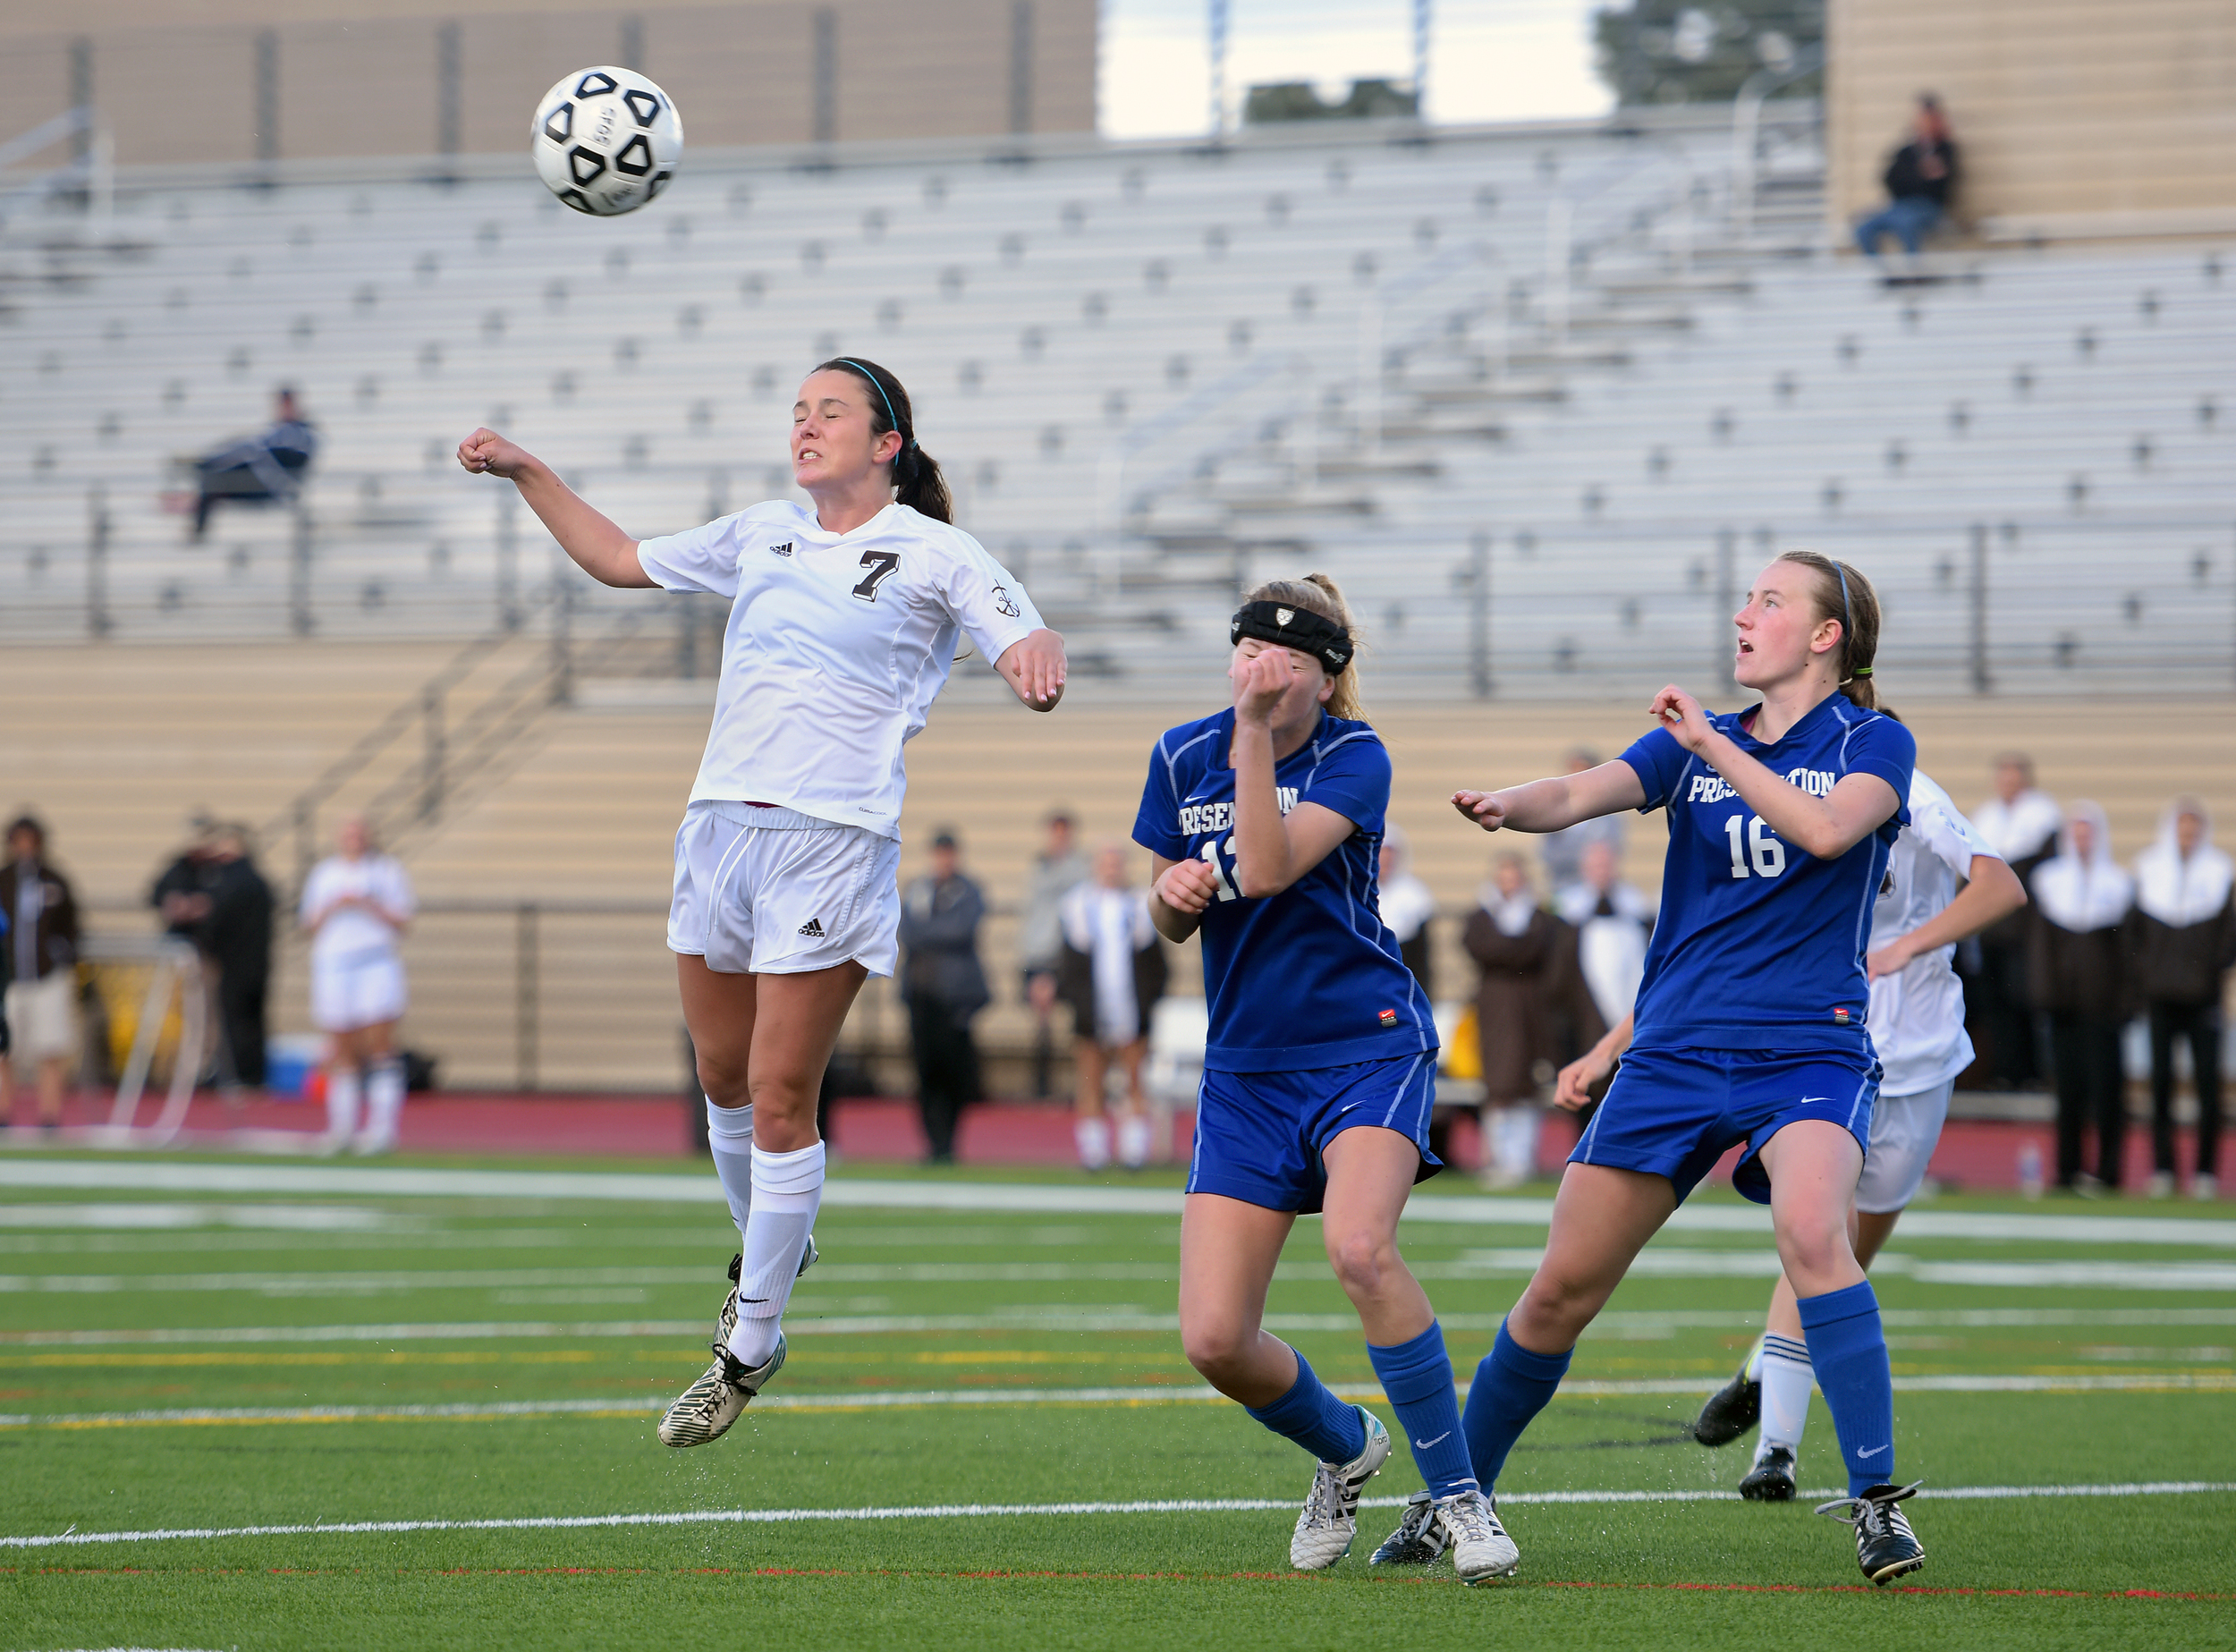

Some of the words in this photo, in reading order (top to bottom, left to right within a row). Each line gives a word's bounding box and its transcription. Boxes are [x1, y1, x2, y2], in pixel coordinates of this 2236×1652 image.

[851, 550, 901, 603] 7
[1687, 767, 1835, 803] PRESTION
[1724, 815, 1786, 878] 16
[798, 928, 826, 938] adidas
